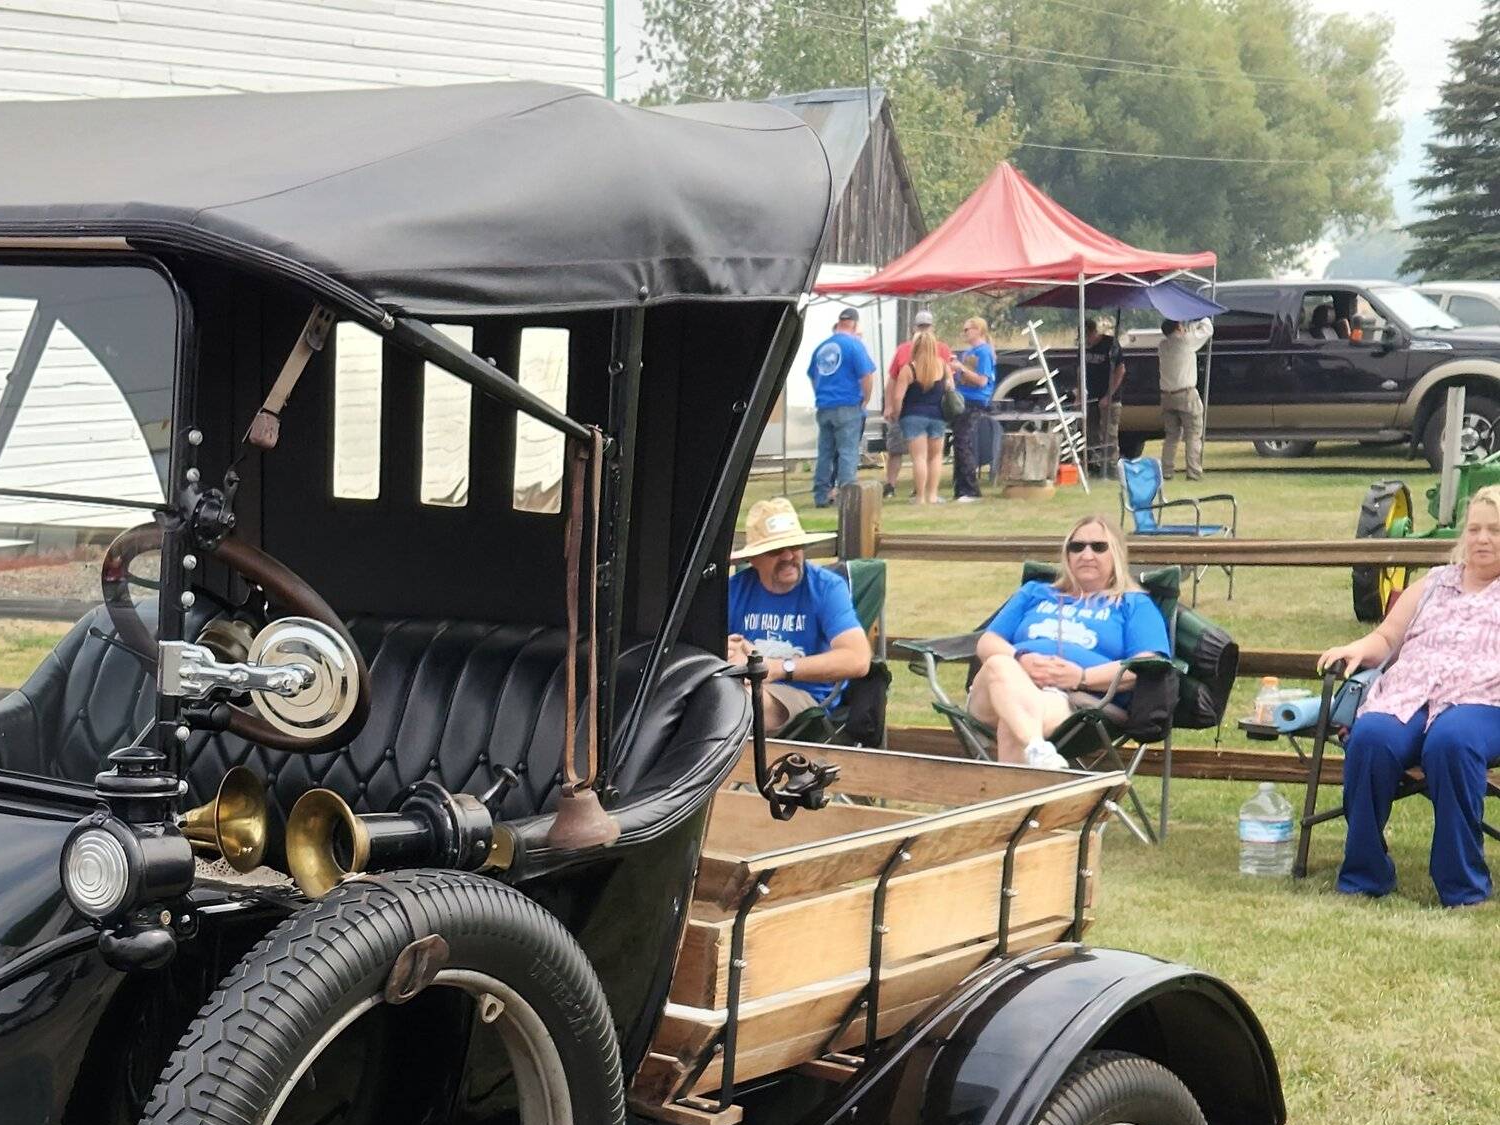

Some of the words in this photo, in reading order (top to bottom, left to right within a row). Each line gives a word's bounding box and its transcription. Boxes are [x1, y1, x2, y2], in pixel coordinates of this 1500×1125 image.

[761, 613, 780, 631] HAD
[781, 614, 795, 632] ME
[795, 614, 807, 632] AT
